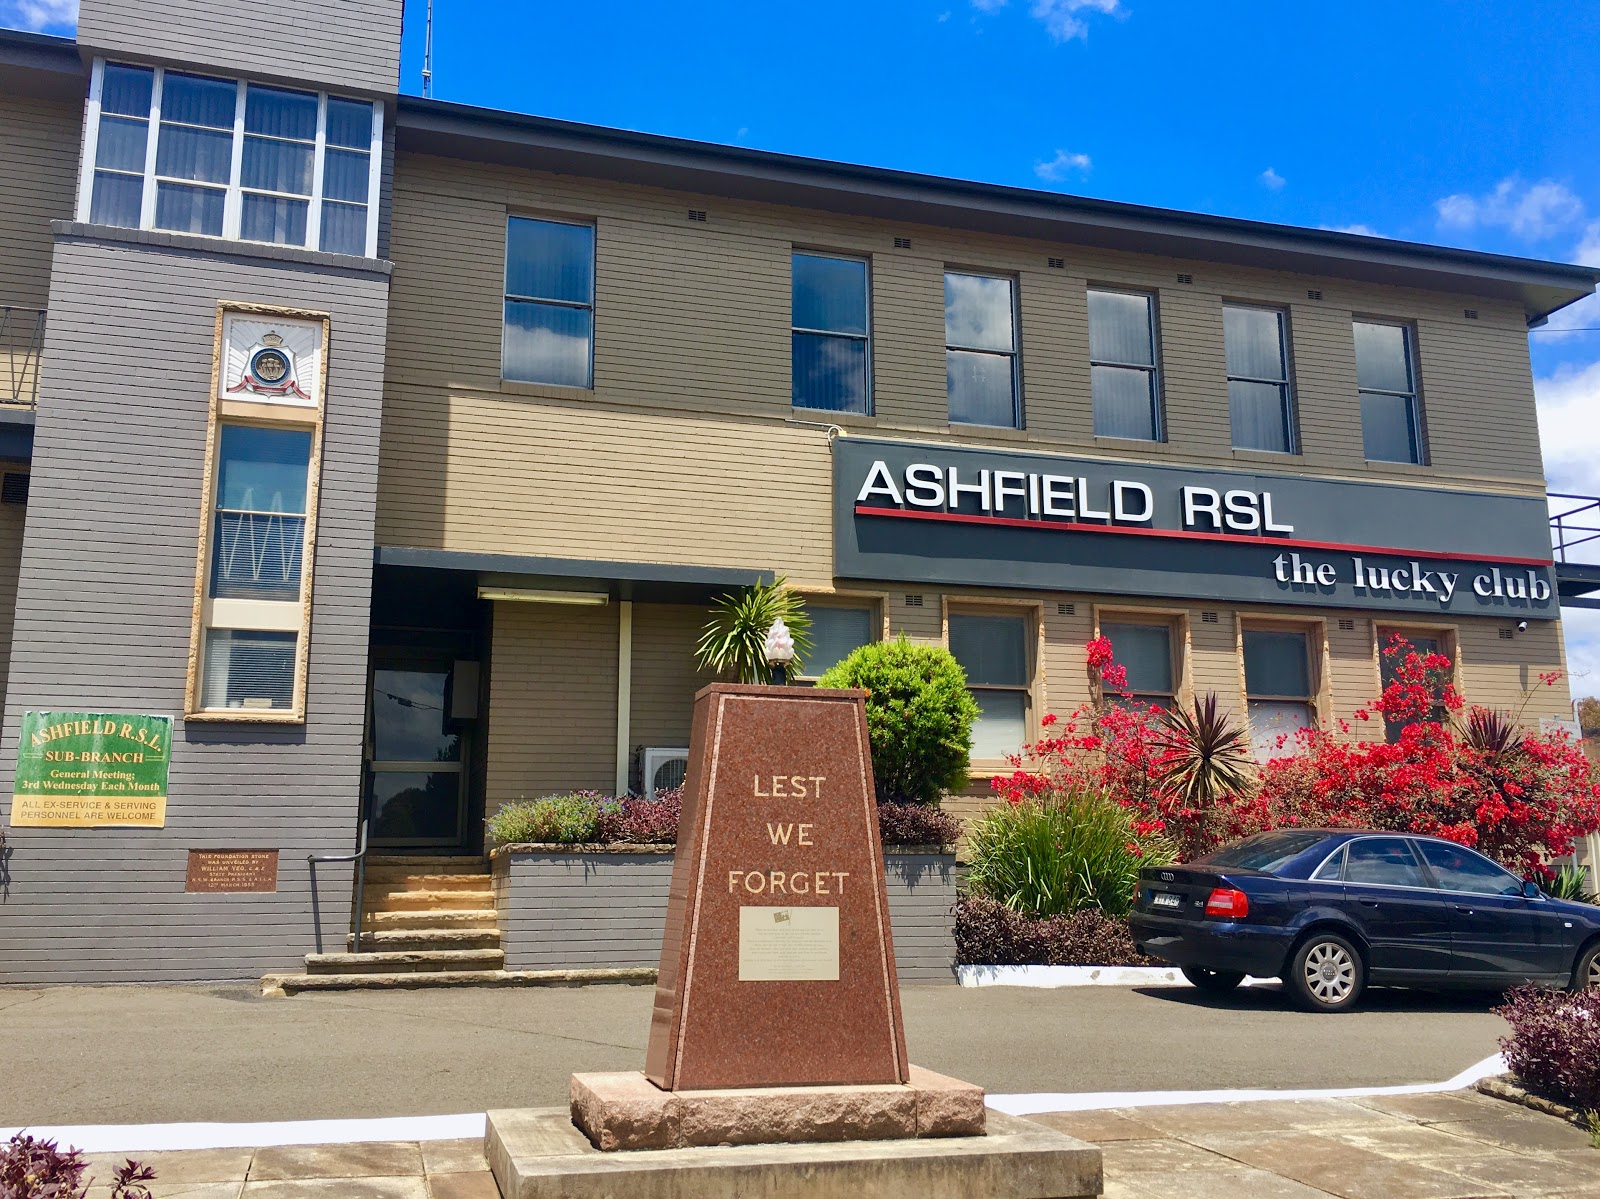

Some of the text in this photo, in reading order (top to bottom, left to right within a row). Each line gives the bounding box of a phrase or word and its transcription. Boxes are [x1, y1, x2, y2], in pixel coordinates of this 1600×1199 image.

[857, 460, 1295, 533] ASHFIELD RSL
[1272, 553, 1550, 602] the lucky club
[31, 720, 162, 752] ASHFIELD R.S.L.
[45, 751, 144, 764] SUB-BRANCH
[50, 769, 90, 779] General
[22, 781, 160, 792] 3rd Wednesday Each Month
[754, 774, 826, 798] LEST
[20, 811, 81, 819] PERSONNEL
[107, 812, 156, 820] WELCOME
[21, 801, 40, 809] ALL
[43, 801, 102, 809] EX-SERVICE
[113, 802, 157, 810] SERVING
[766, 823, 814, 846] WE
[728, 870, 850, 895] FORGET
